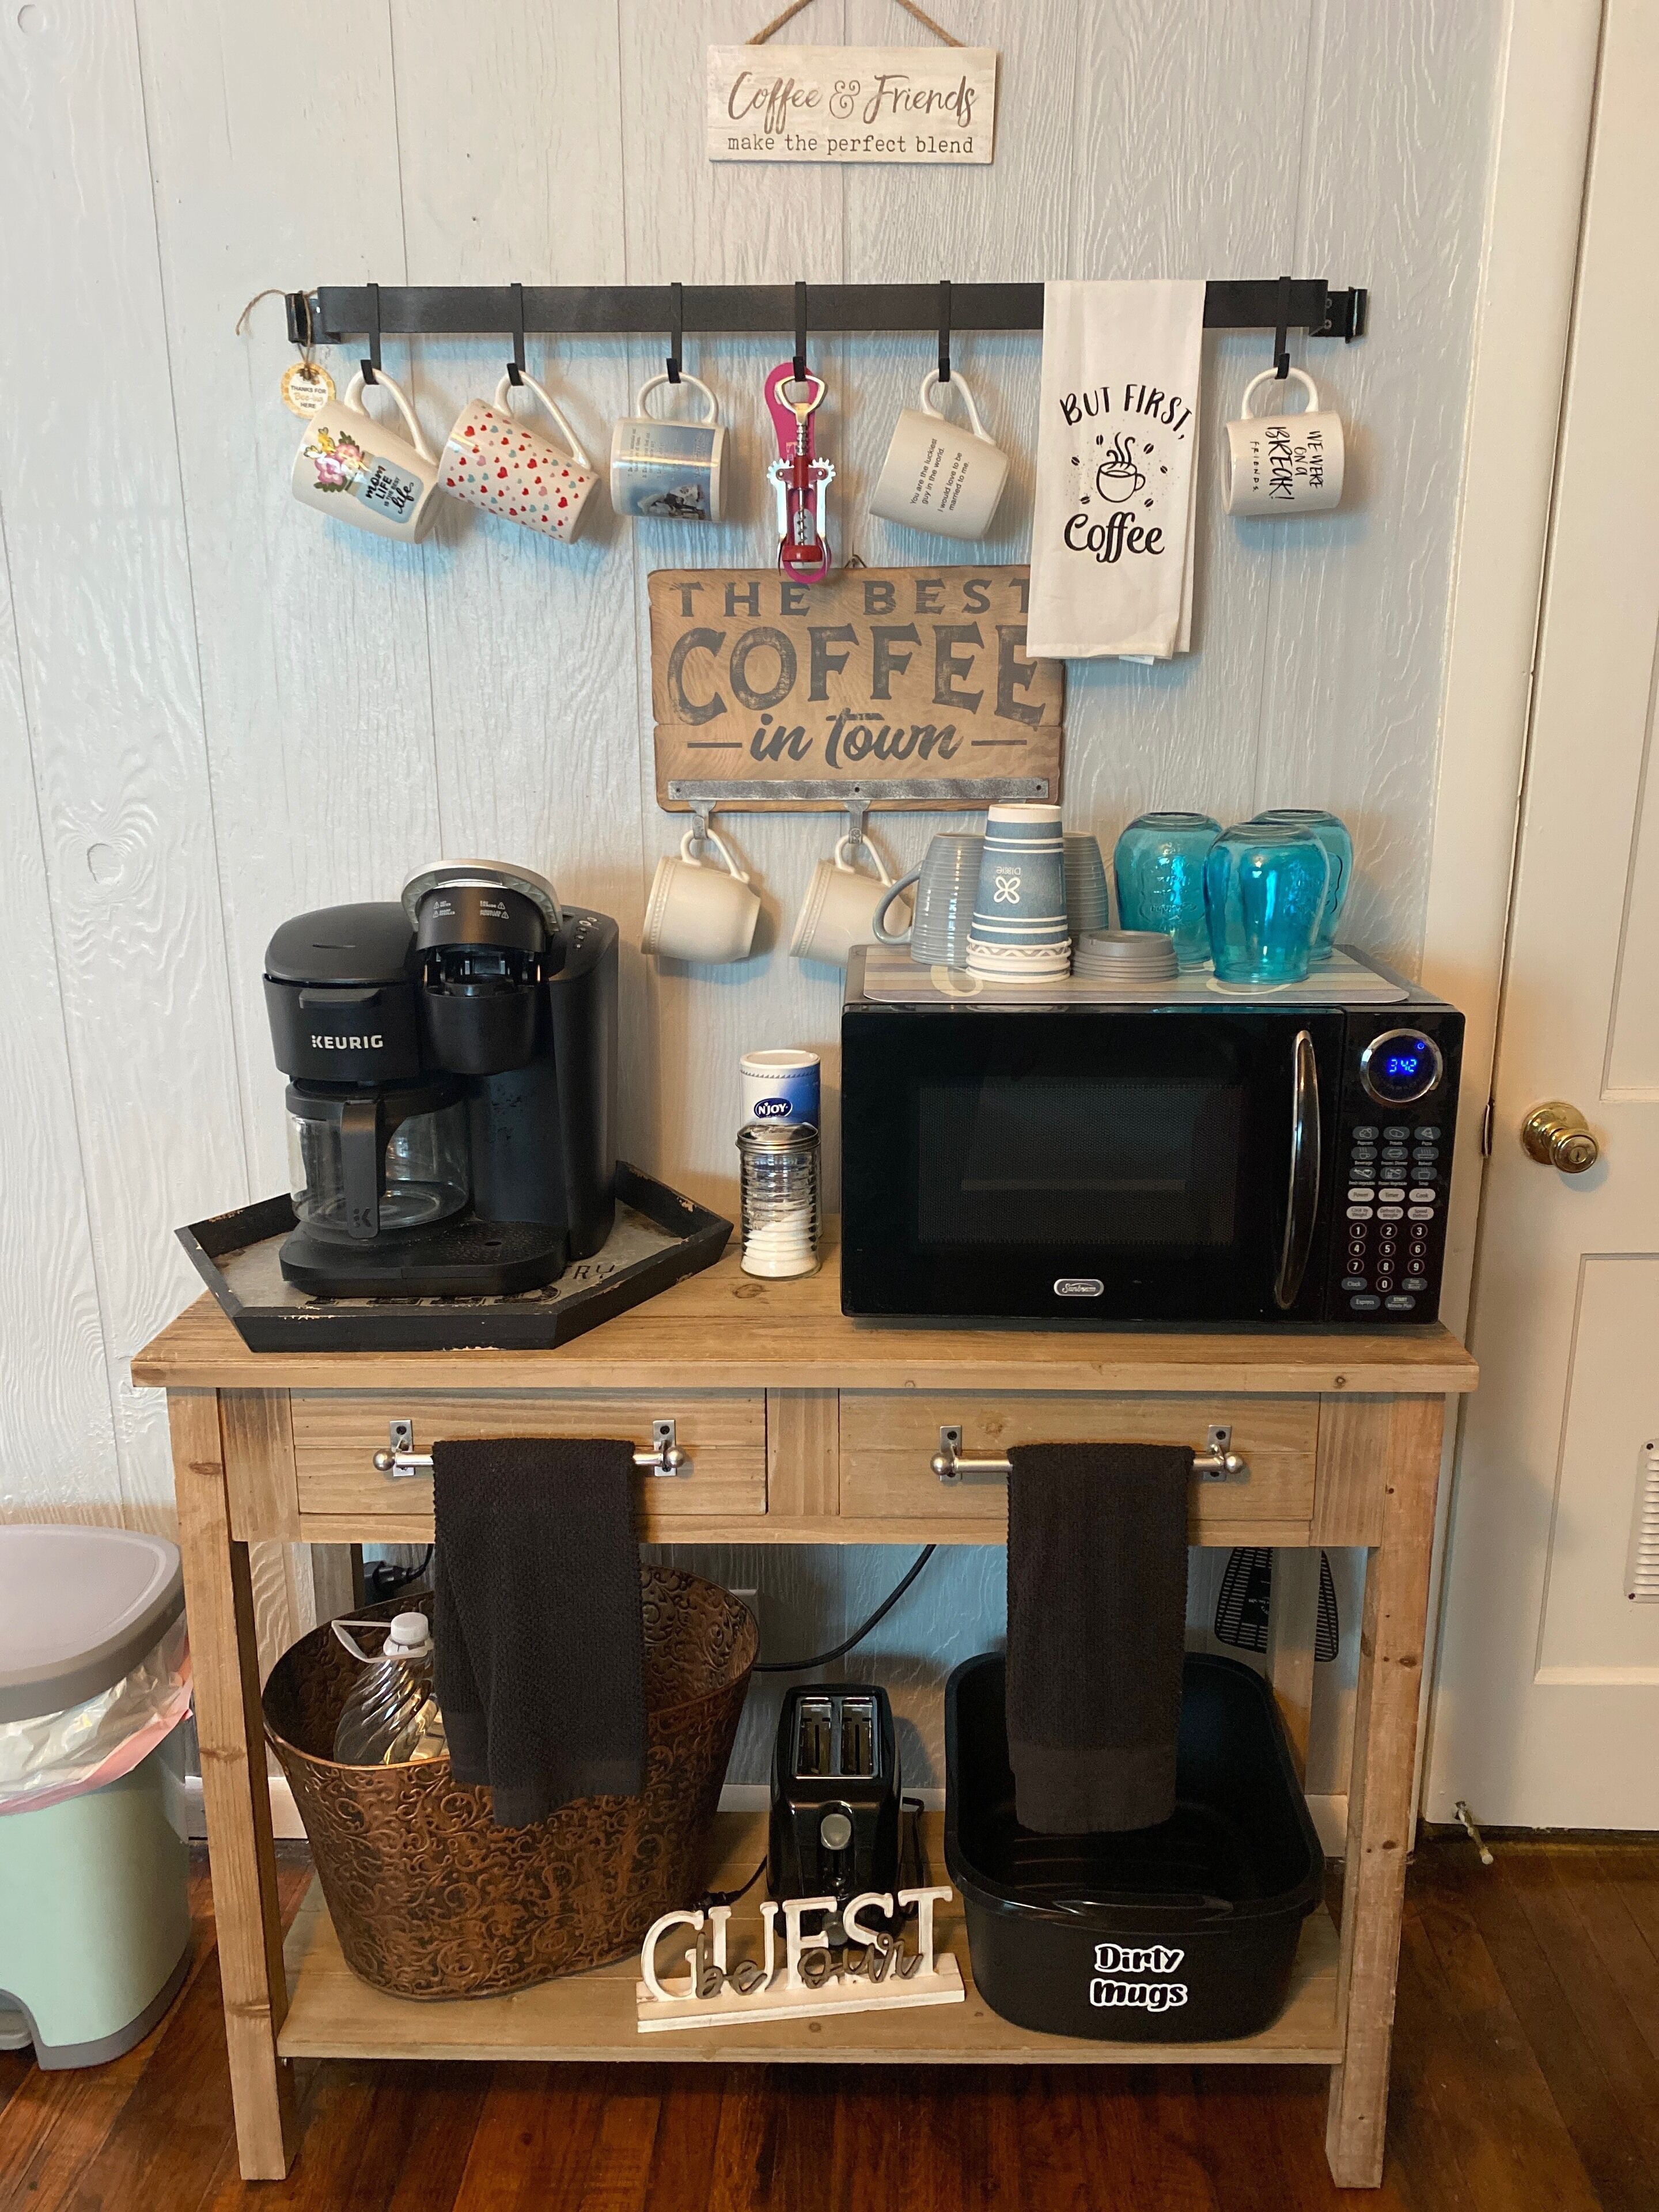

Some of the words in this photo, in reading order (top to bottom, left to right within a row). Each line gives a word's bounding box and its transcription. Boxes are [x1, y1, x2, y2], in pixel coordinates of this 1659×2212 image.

[728, 71, 821, 135] Coffee
[830, 79, 861, 119] &
[863, 75, 978, 127] Friends
[728, 134, 775, 150] make
[785, 134, 817, 151] the
[827, 136, 907, 155] perfect
[916, 137, 974, 153] blend
[290, 385, 313, 393] THANKS
[1060, 387, 1110, 426] BUT
[924, 438, 938, 465] luckiest
[1306, 430, 1324, 453] WE
[952, 461, 960, 470] to
[955, 452, 963, 462] be
[1294, 446, 1308, 464] ON
[920, 465, 929, 478] the
[929, 469, 937, 482] the
[946, 470, 956, 487] love
[1309, 454, 1324, 490] WERE
[375, 475, 392, 499] LIFE
[916, 479, 925, 492] are
[926, 483, 933, 491] in
[949, 483, 962, 511] married
[957, 475, 965, 483] to
[391, 482, 415, 514] life
[910, 492, 920, 505] You
[922, 491, 931, 505] guy
[940, 487, 951, 510] would
[1064, 511, 1165, 563] Coffee
[669, 581, 810, 618] THE
[667, 621, 1046, 732] COFFEE
[749, 713, 813, 762] in
[825, 707, 964, 770] town
[312, 1035, 384, 1050] KEURIG
[1356, 1226, 1361, 1235] 1
[1385, 1226, 1392, 1236] 2
[1416, 1227, 1423, 1236] 3
[1354, 1244, 1360, 1253] 4
[1384, 1245, 1391, 1253] 5
[1415, 1245, 1421, 1253] 6
[1353, 1262, 1359, 1271] 7
[1383, 1262, 1389, 1271] 8
[1413, 1263, 1419, 1271] 9
[1381, 1280, 1388, 1289] 0
[641, 1885, 953, 2002] GUEST
[695, 1931, 768, 2000] be
[797, 1930, 925, 1989] our
[1094, 1943, 1185, 1973] Dirty
